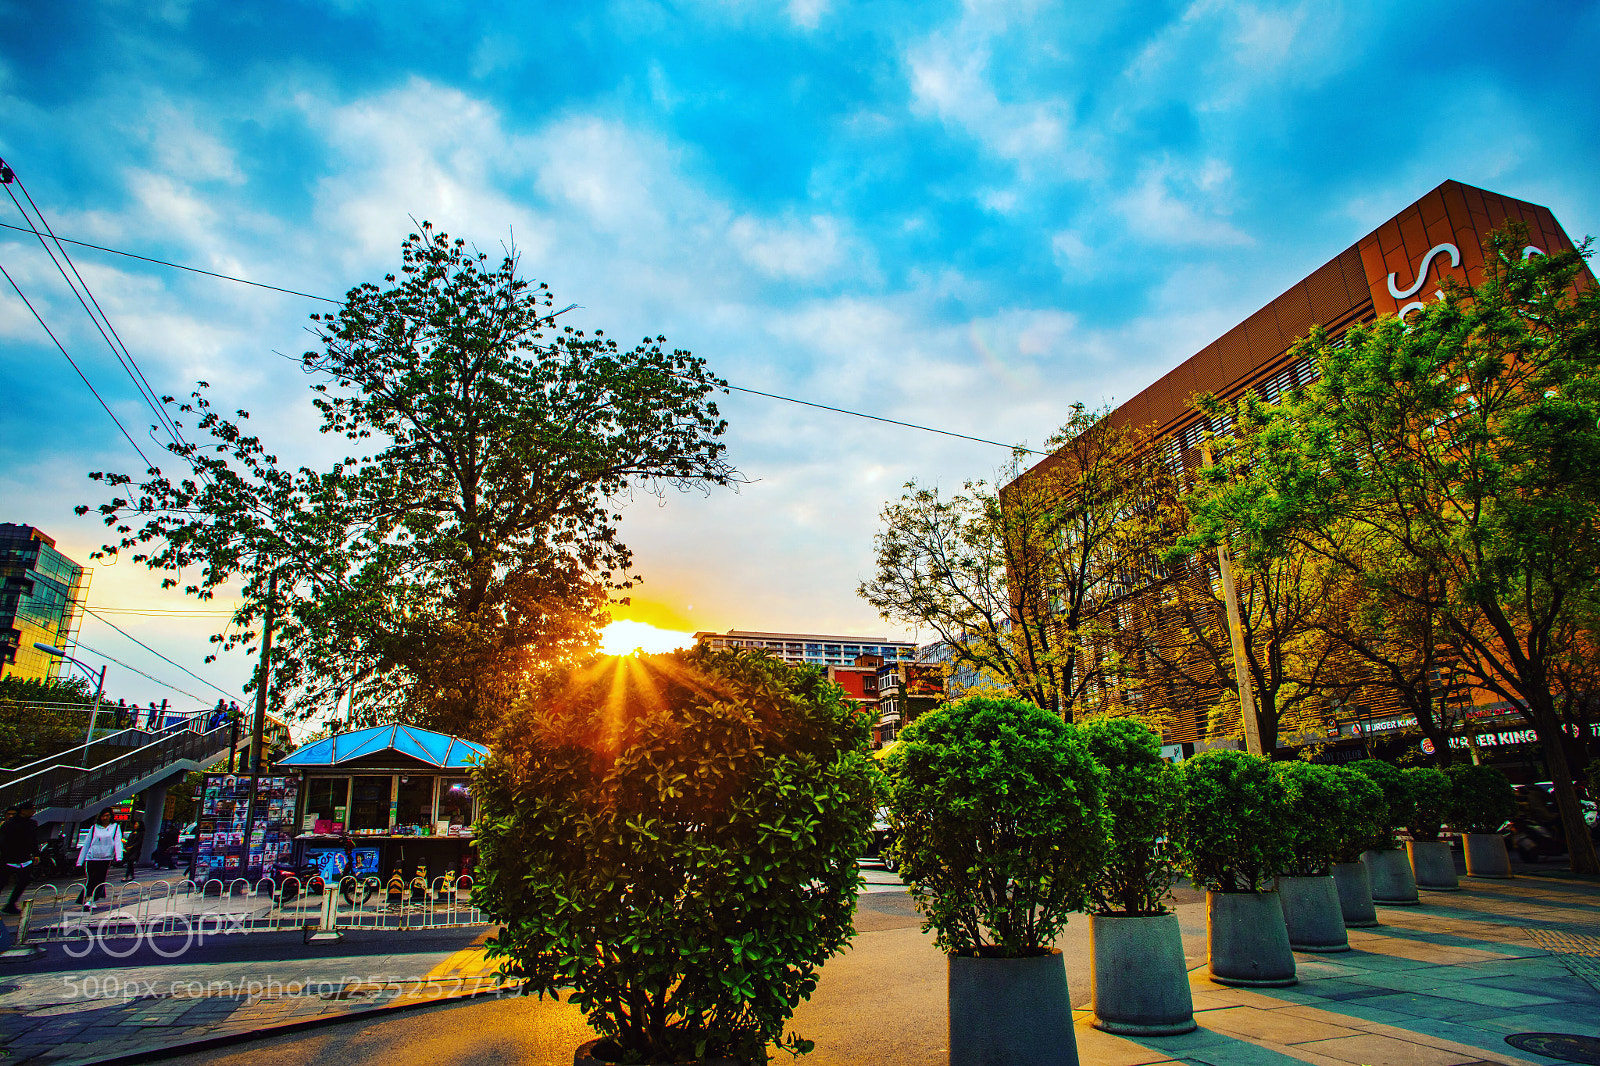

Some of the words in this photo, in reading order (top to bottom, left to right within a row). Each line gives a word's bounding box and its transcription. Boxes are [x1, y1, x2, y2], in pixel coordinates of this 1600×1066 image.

[1365, 719, 1397, 733] BURGER
[1397, 716, 1418, 728] KING
[1447, 733, 1498, 749] URER
[1497, 729, 1538, 745] KING
